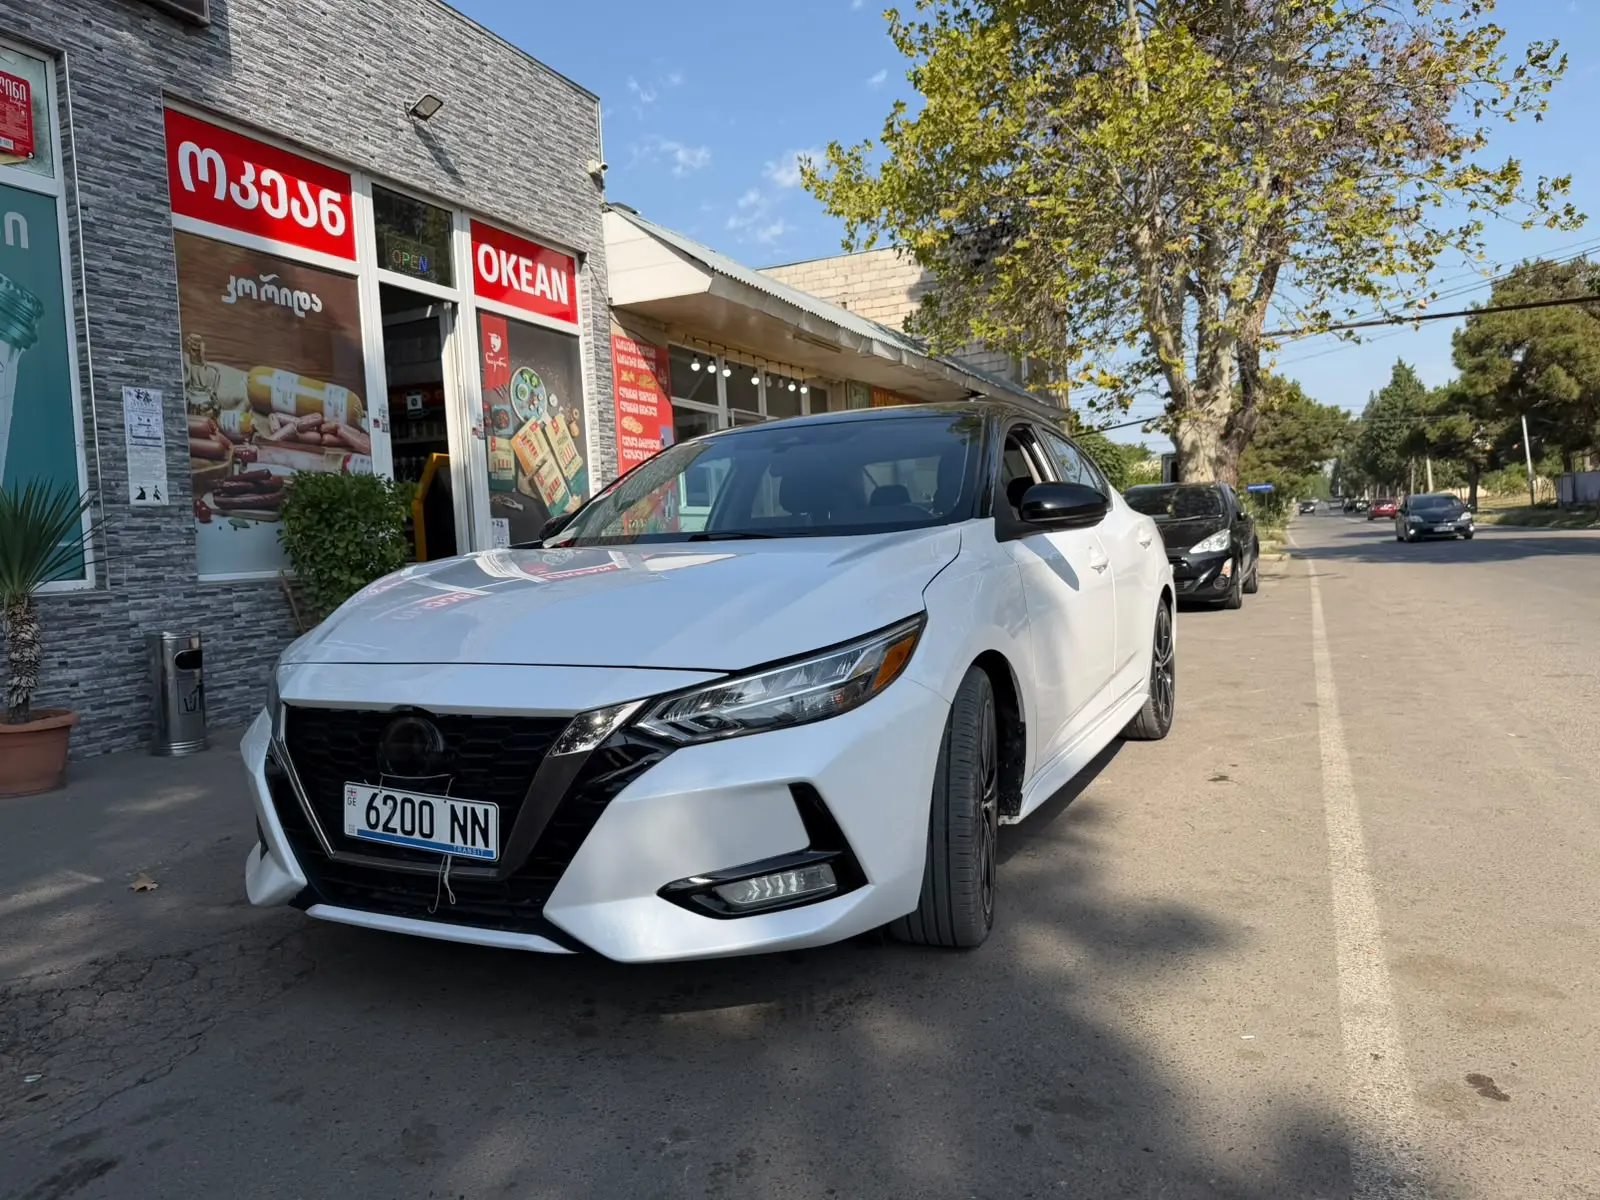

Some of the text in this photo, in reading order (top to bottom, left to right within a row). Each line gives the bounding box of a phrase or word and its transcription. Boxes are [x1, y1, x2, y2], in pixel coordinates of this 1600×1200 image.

[177, 141, 346, 236] ოკეან
[392, 250, 428, 272] OPEN
[477, 243, 569, 305] OKEAN
[347, 797, 357, 806] GE
[365, 792, 489, 848] 6200 NN
[453, 845, 483, 856] TRANSIT
